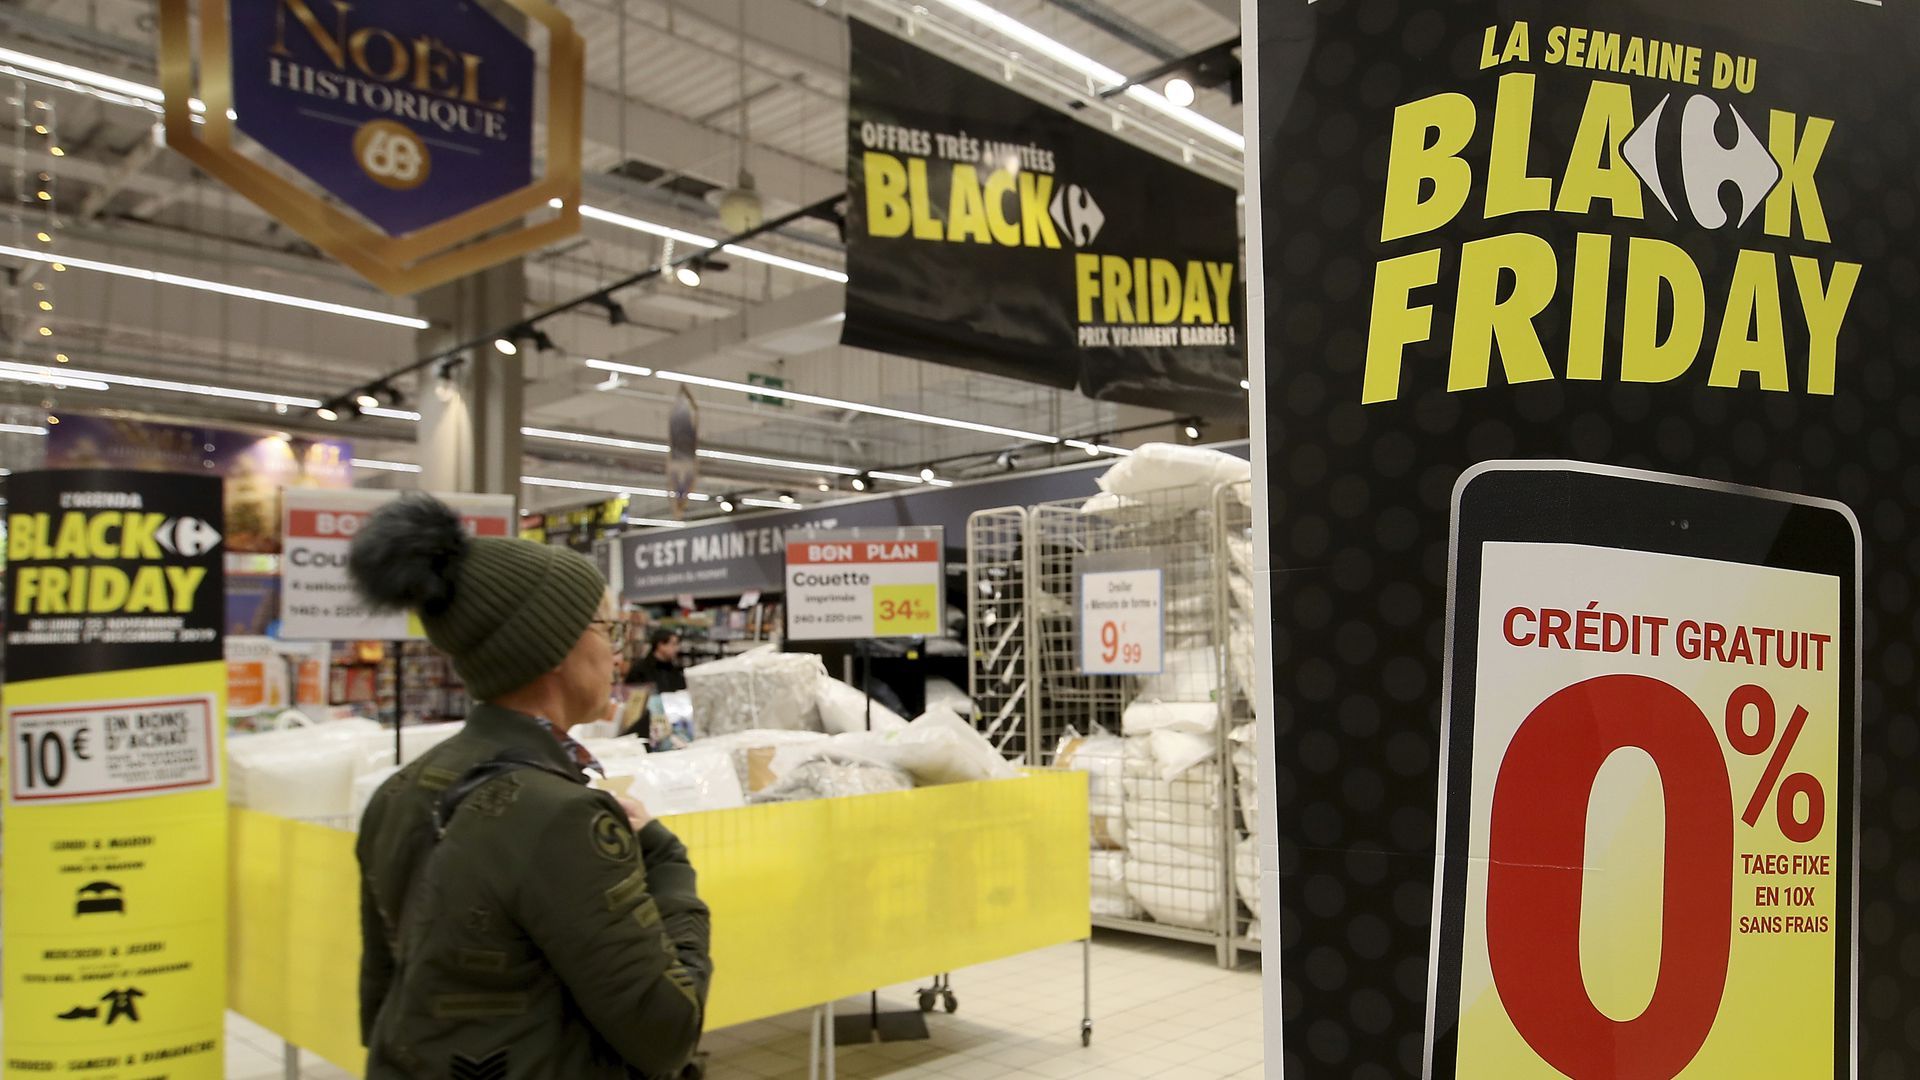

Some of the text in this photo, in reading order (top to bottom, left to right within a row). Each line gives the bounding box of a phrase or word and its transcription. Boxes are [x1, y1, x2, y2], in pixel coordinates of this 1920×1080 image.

[1479, 21, 1758, 94] LA SEMAINE DU
[268, 57, 508, 141] HISTORIQUE
[861, 120, 932, 155] OFFRES
[935, 131, 981, 163] TRÈS
[863, 151, 1062, 249] BLACK
[1075, 253, 1234, 325] FRIDAY
[1078, 326, 1110, 347] PRIX
[1112, 326, 1178, 347] VRAIMENT
[1180, 323, 1227, 347] BARRÉS
[1362, 232, 1863, 404] FRIDAY
[8, 511, 166, 560] BLACK
[635, 538, 688, 569] C'EST
[808, 543, 918, 562] BON PLAN
[14, 565, 207, 614] FRIDAY
[793, 571, 870, 587] Couette
[879, 599, 913, 622] 34
[1101, 620, 1119, 664] 9
[1122, 643, 1143, 664] 99
[1502, 601, 1832, 671] CRÉDIT GRATUIT
[1740, 854, 1830, 876] TAEG FIXE
[1754, 885, 1816, 907] EN 10X
[1738, 915, 1829, 934] SANS FRAIS
